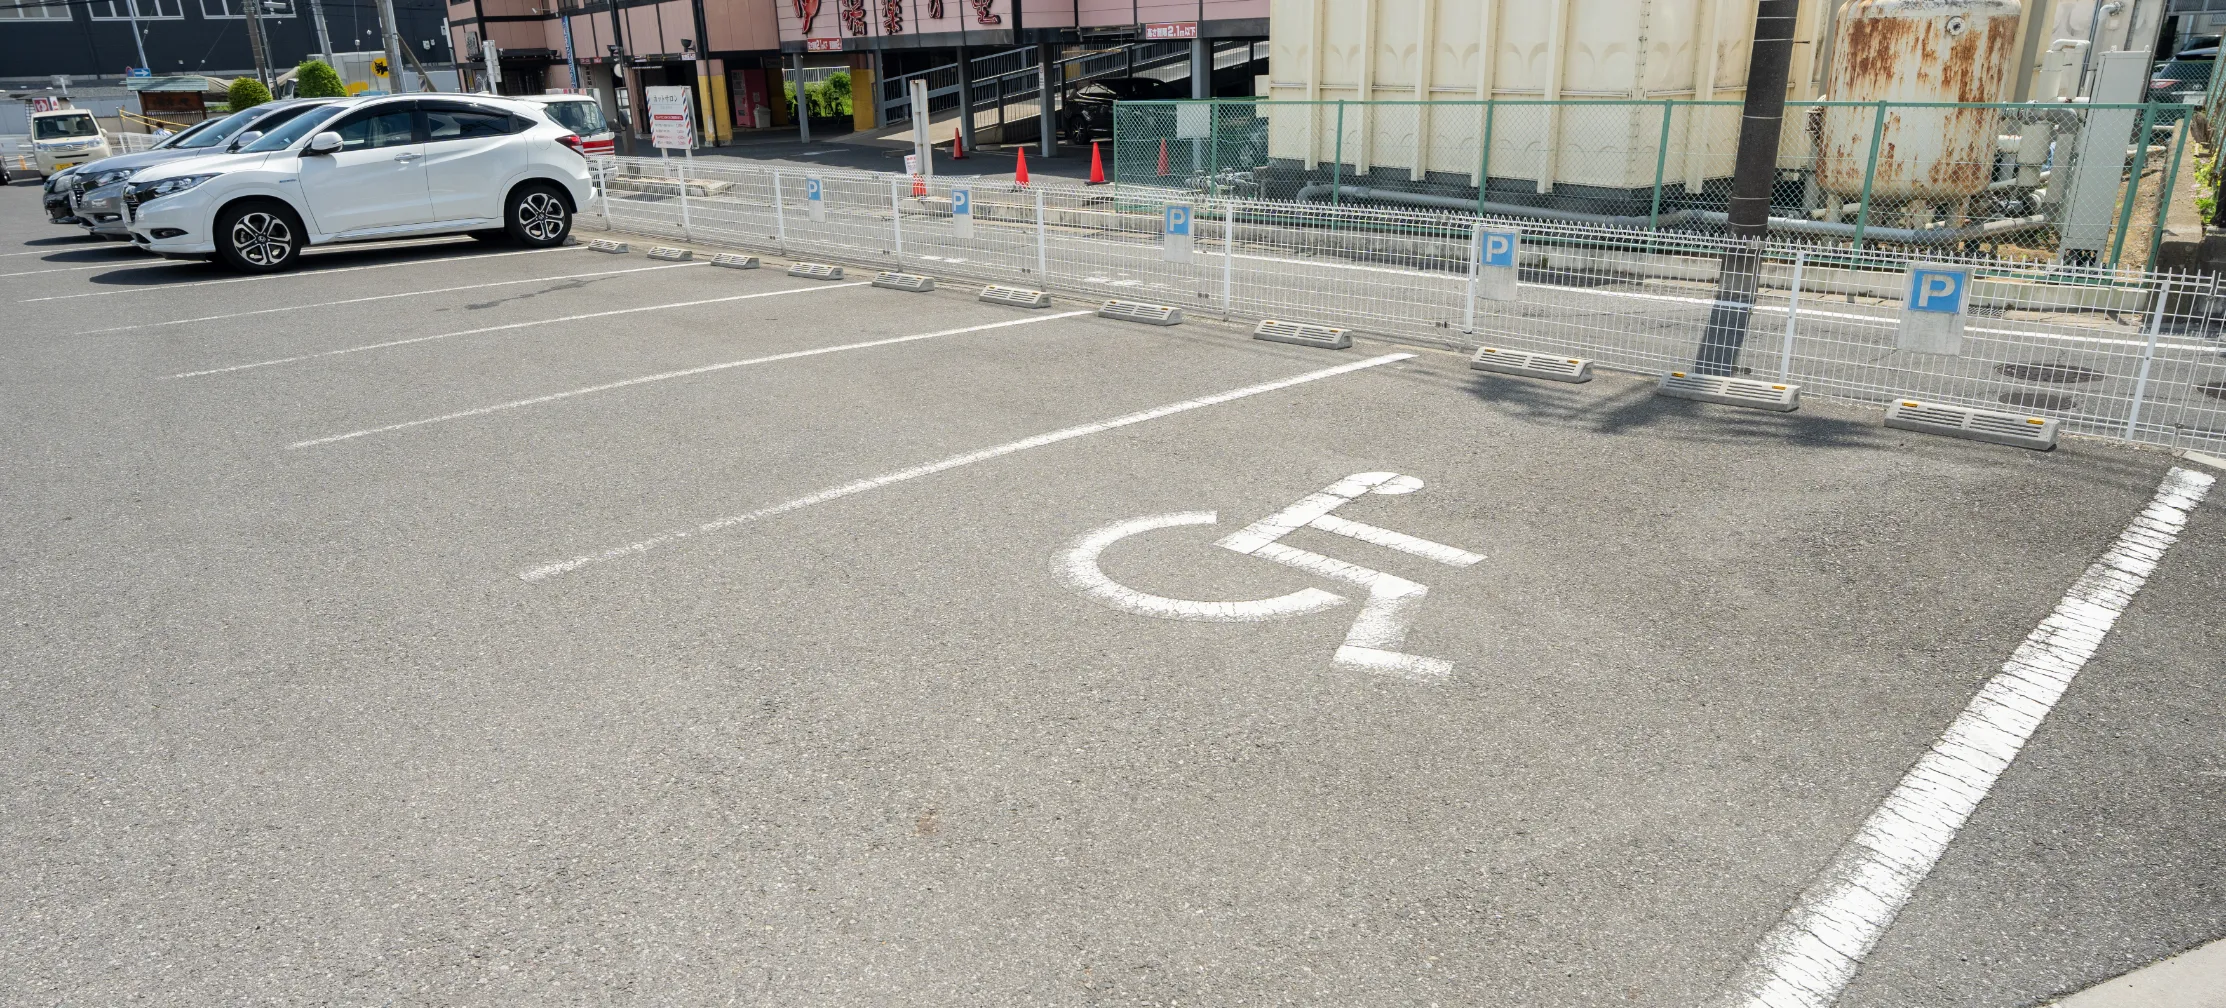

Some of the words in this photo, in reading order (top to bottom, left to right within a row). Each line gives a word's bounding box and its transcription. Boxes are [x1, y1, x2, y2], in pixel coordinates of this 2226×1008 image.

[808, 180, 818, 198] P
[953, 191, 966, 211] P
[1170, 209, 1186, 231] P
[1486, 235, 1509, 262] P
[1918, 274, 1956, 307] P
